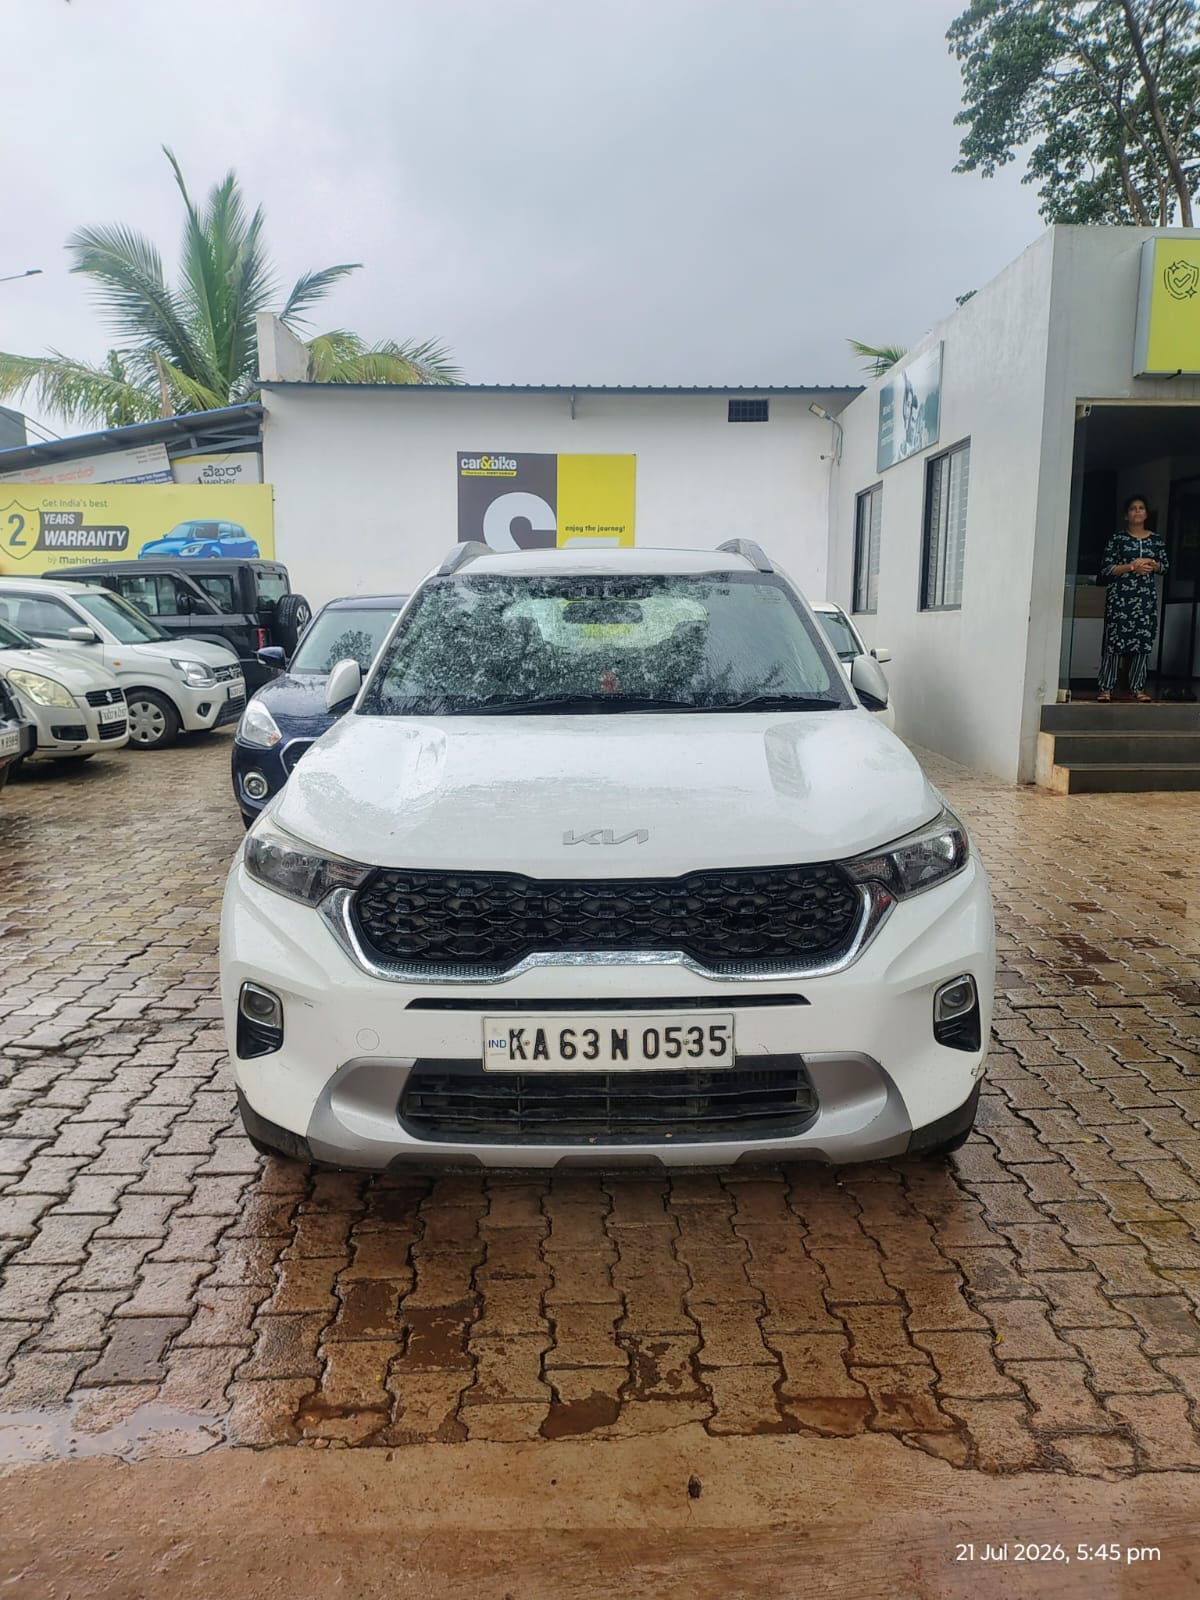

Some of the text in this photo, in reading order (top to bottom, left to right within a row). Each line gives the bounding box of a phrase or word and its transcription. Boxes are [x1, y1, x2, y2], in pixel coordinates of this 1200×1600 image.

[461, 455, 517, 470] car&bike
[42, 499, 108, 508] Get India's best
[43, 513, 75, 525] YEARS
[8, 513, 27, 546] 2
[44, 530, 127, 547] WARRANTY
[48, 555, 57, 564] by
[562, 829, 649, 845] KIA
[488, 1025, 727, 1060] IND KA 63 N 0535
